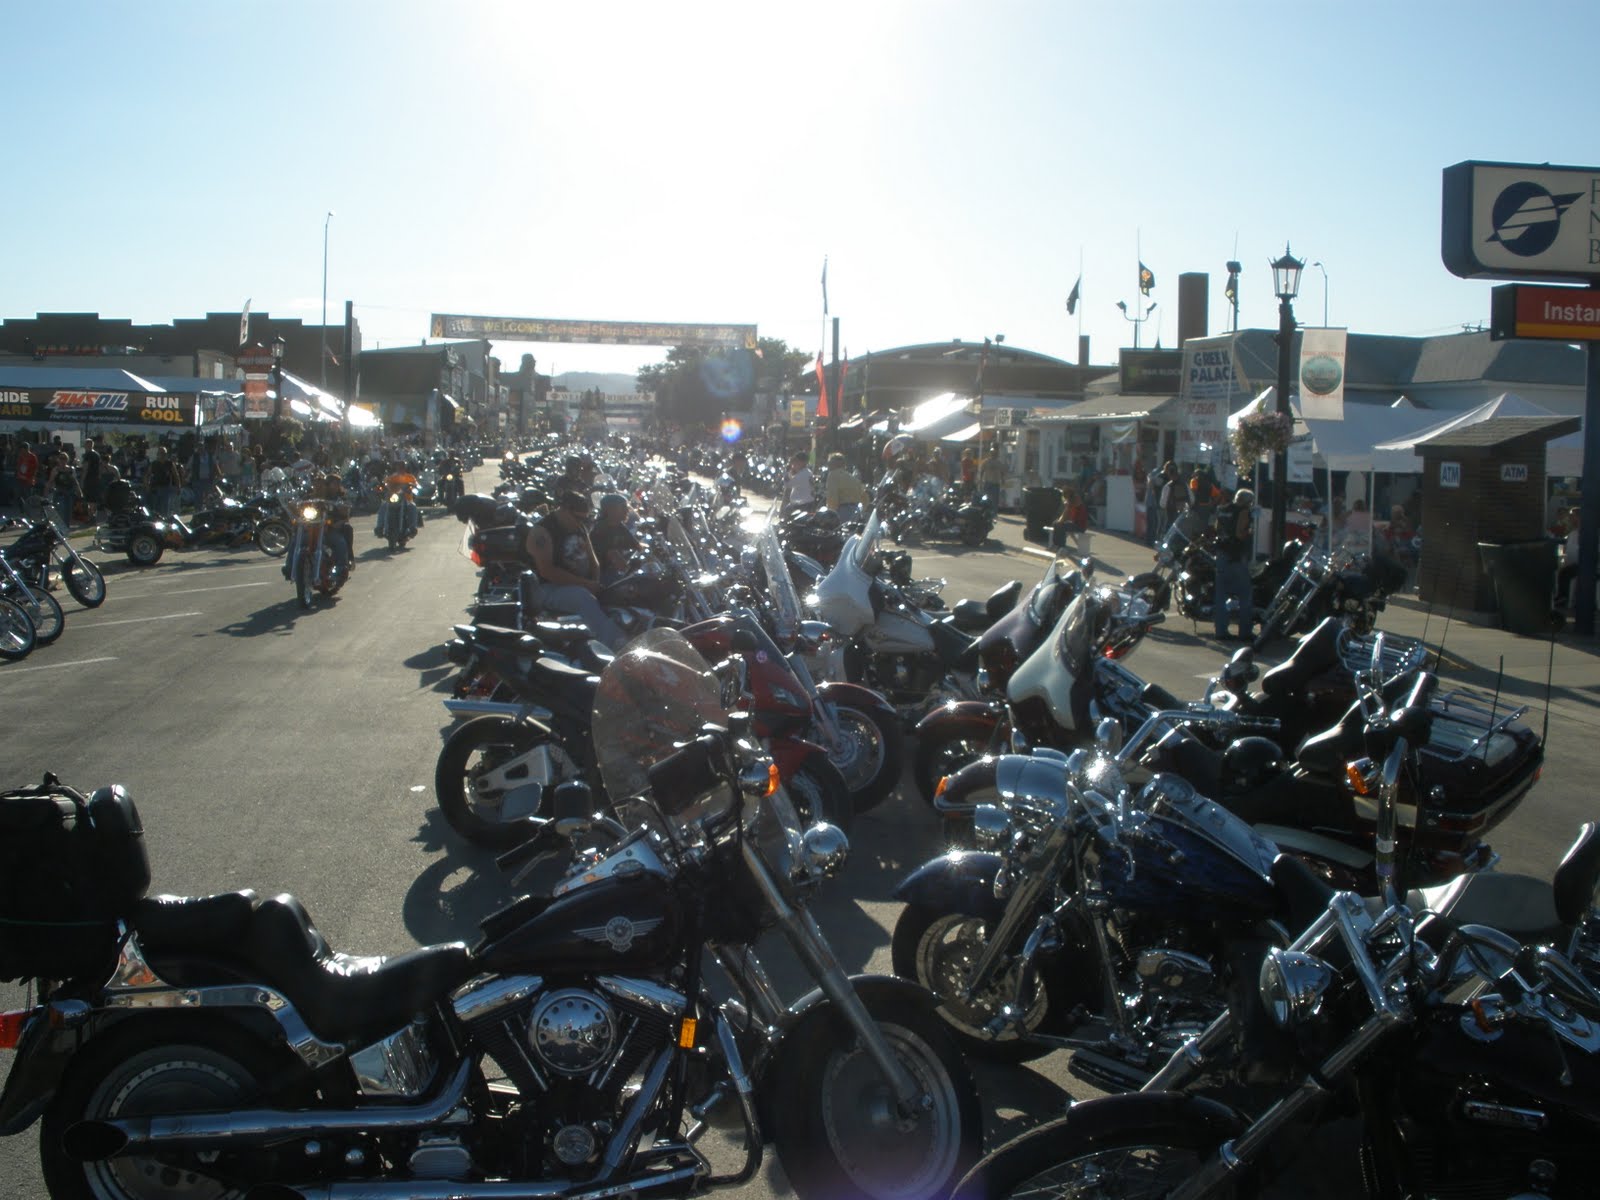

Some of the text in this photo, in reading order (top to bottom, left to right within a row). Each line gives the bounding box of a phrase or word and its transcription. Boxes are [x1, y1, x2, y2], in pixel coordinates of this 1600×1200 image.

[1193, 350, 1231, 366] GREEK
[1190, 366, 1237, 382] PALACE
[44, 391, 129, 412] AMSOIL
[145, 396, 180, 409] RUN
[0, 404, 33, 416] ARD
[140, 408, 184, 423] COOL
[1441, 466, 1459, 483] ATM
[1504, 466, 1526, 479] ATM
